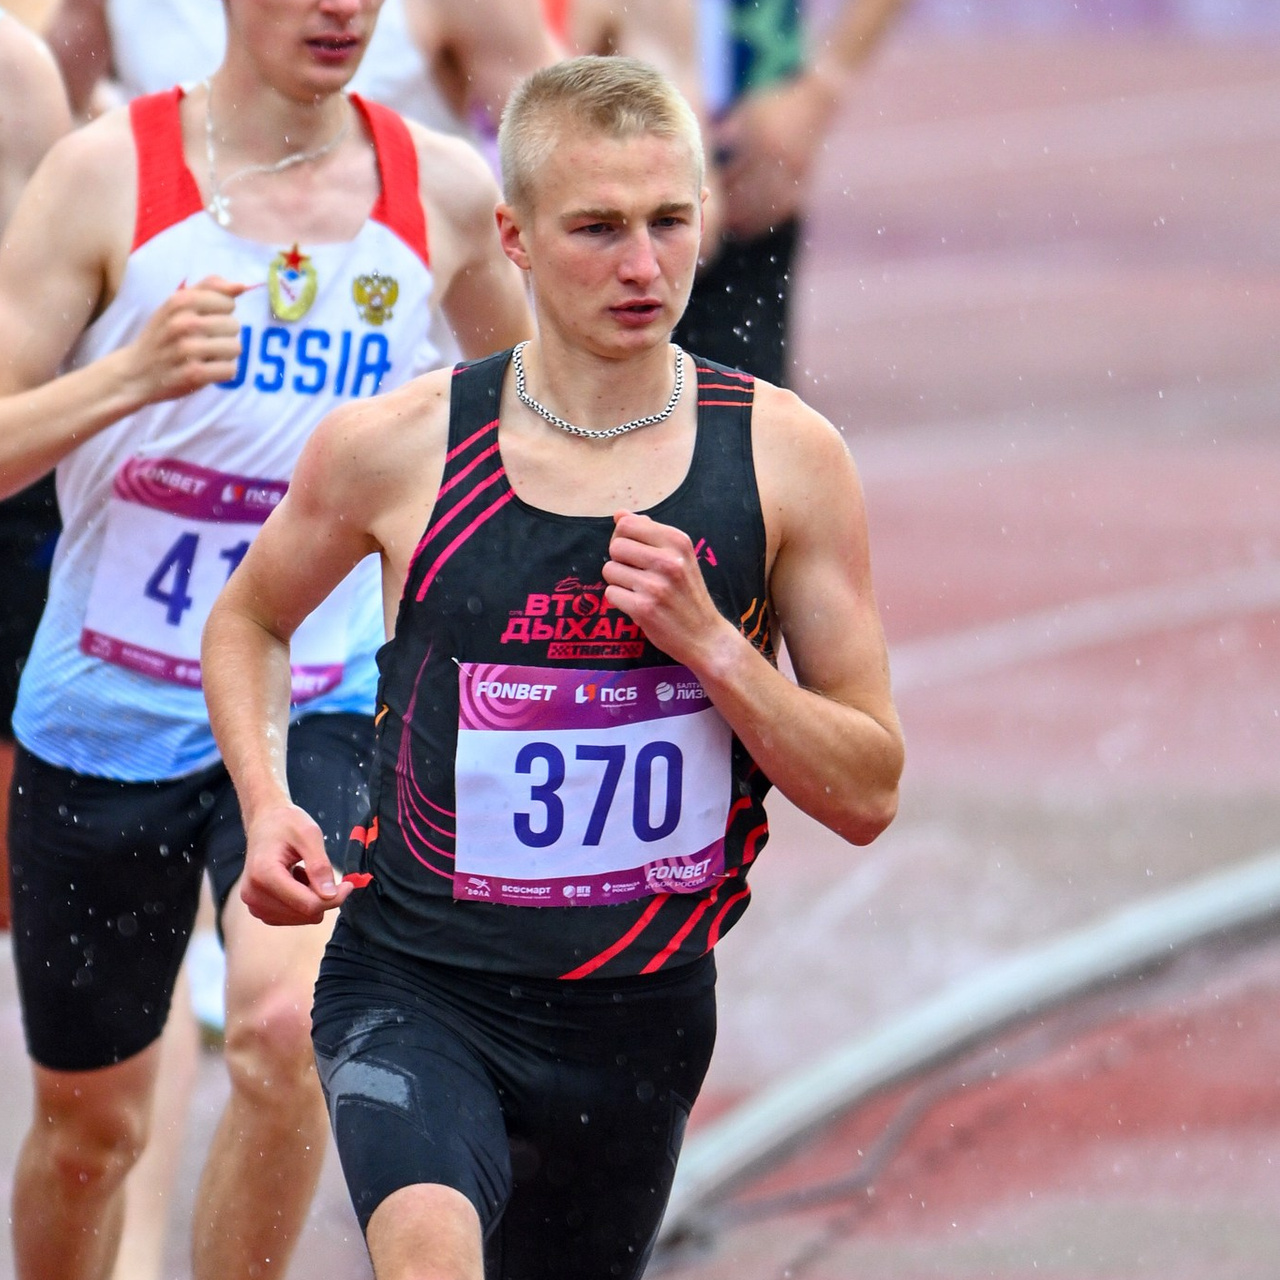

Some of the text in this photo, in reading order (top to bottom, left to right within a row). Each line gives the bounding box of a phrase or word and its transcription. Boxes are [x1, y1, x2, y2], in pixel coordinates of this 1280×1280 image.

[215, 325, 392, 397] USSIA
[500, 617, 646, 644] ДЫХАН
[475, 681, 558, 702] FONBET
[600, 686, 638, 703] ПСБ
[675, 689, 707, 700] ЛИЗ
[513, 741, 683, 848] 370
[646, 859, 712, 882] FONBET
